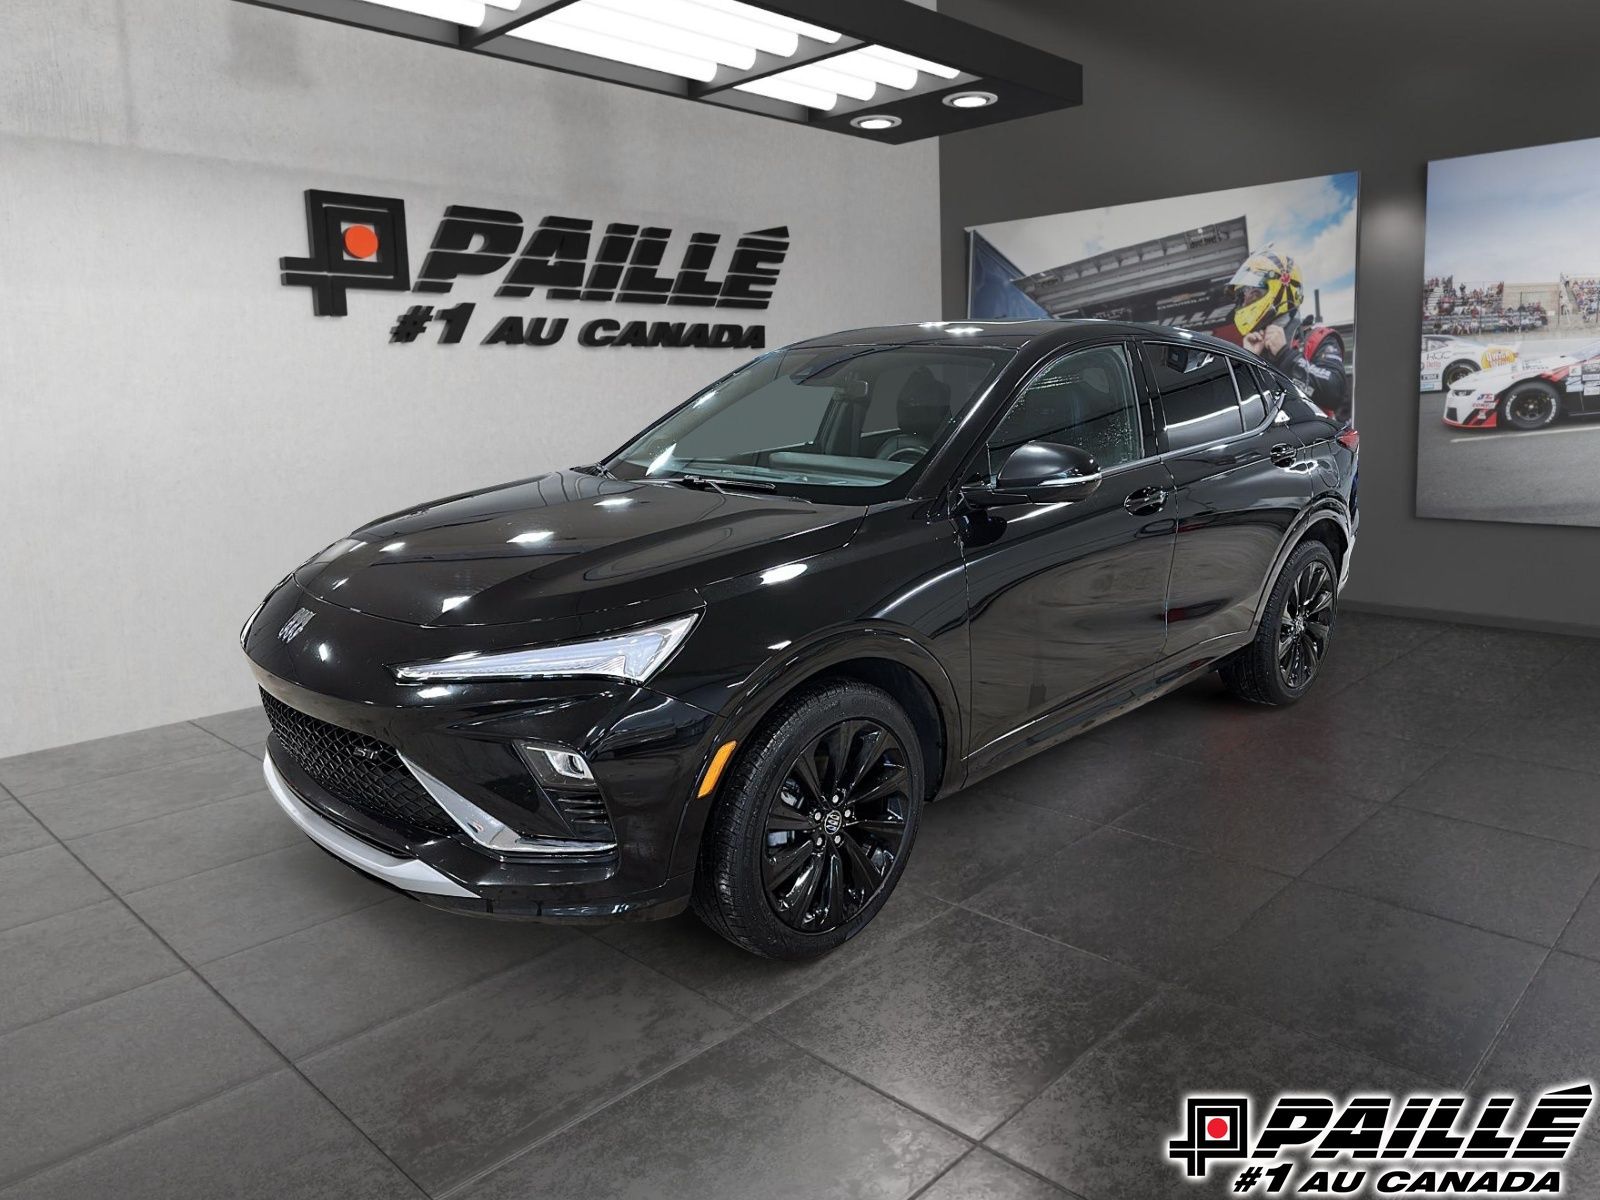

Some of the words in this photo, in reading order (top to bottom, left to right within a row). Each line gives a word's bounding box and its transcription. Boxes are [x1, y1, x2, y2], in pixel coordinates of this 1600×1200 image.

[411, 205, 790, 310] PAILLÉ
[388, 302, 477, 345] #1
[480, 316, 570, 346] AU
[577, 318, 767, 349] CANADA
